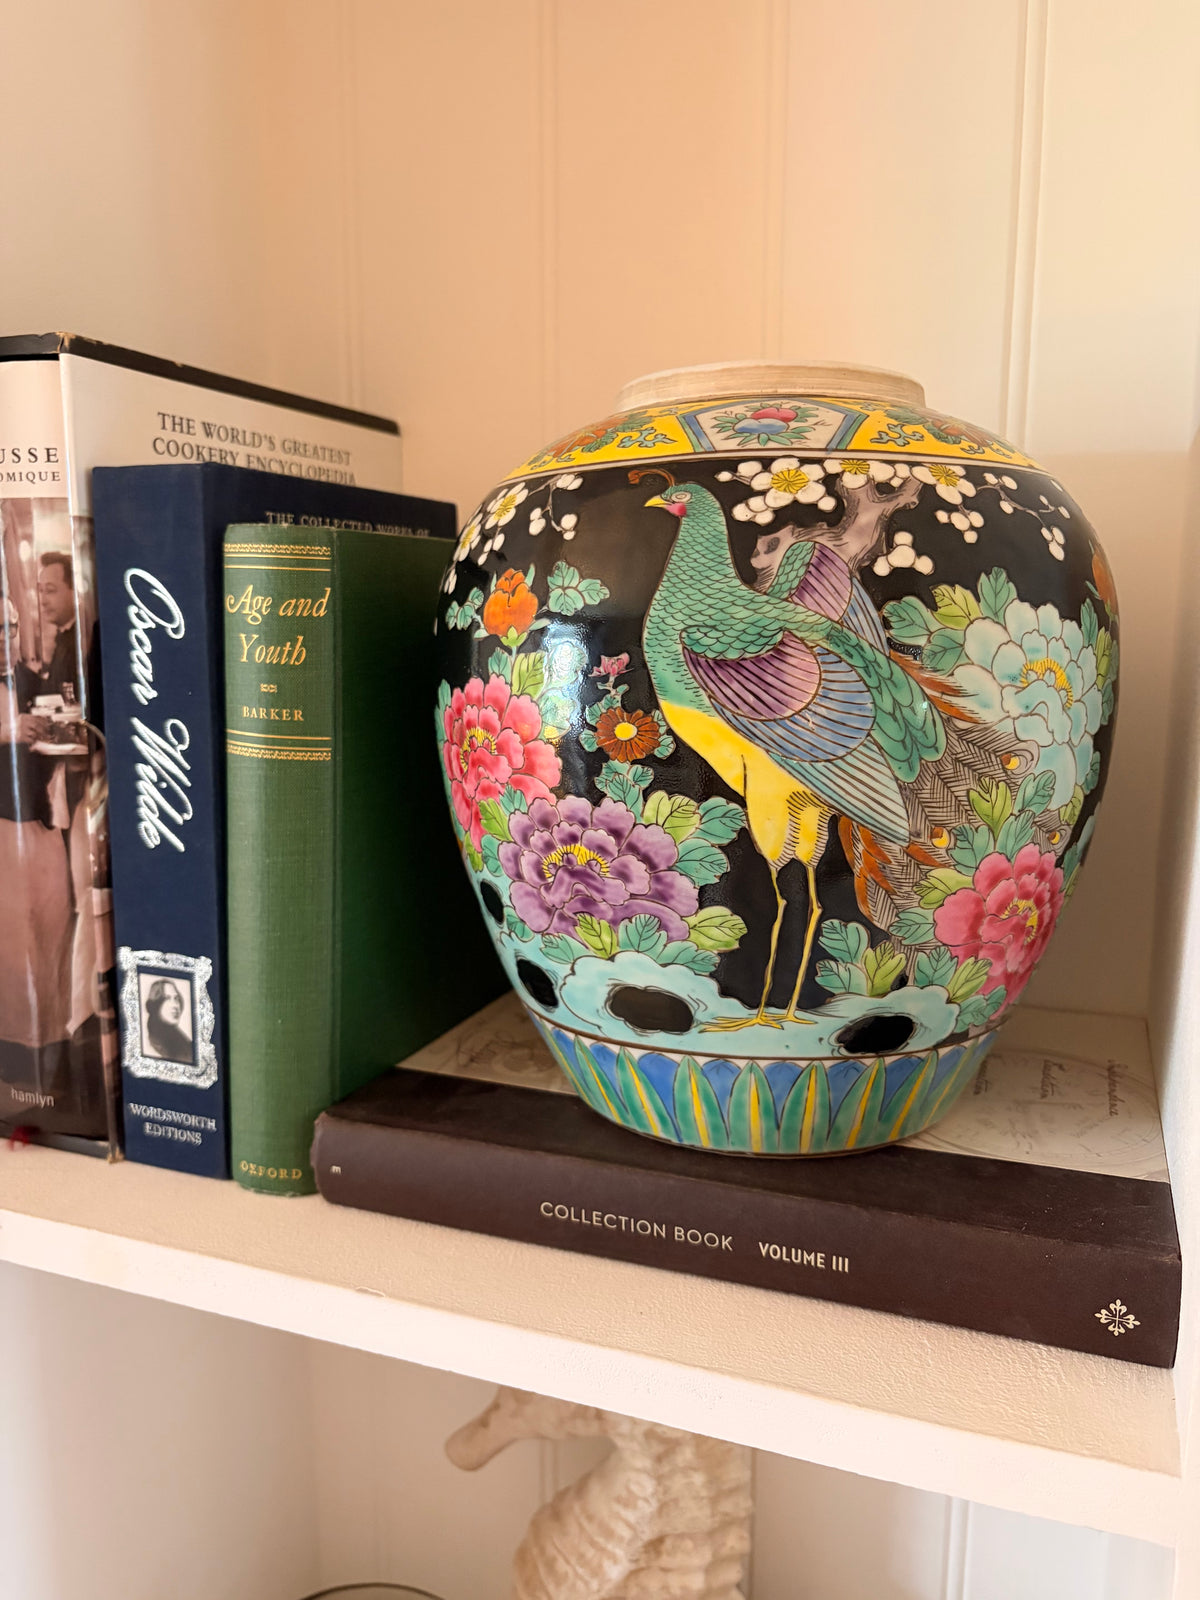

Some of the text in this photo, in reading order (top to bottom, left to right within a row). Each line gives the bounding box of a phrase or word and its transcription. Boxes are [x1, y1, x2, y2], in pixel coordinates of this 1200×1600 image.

[157, 412, 353, 466] THE WORLD'S GREATEST
[153, 437, 356, 487] COOKERY ENCYCLOPEDIA
[265, 511, 295, 525] THE
[300, 515, 373, 532] COLLECTED
[226, 584, 331, 625] Age and
[239, 633, 307, 666] Youth
[124, 567, 194, 853] Oscar Wilde
[242, 705, 304, 722] BARKER
[11, 1087, 55, 1108] hamlyn
[128, 1102, 217, 1132] WORDSWORTH
[143, 1122, 202, 1146] EDITIONS
[239, 1159, 303, 1180] OXFORD
[540, 1201, 850, 1273] COLLECTION BOOK VOLUME III
